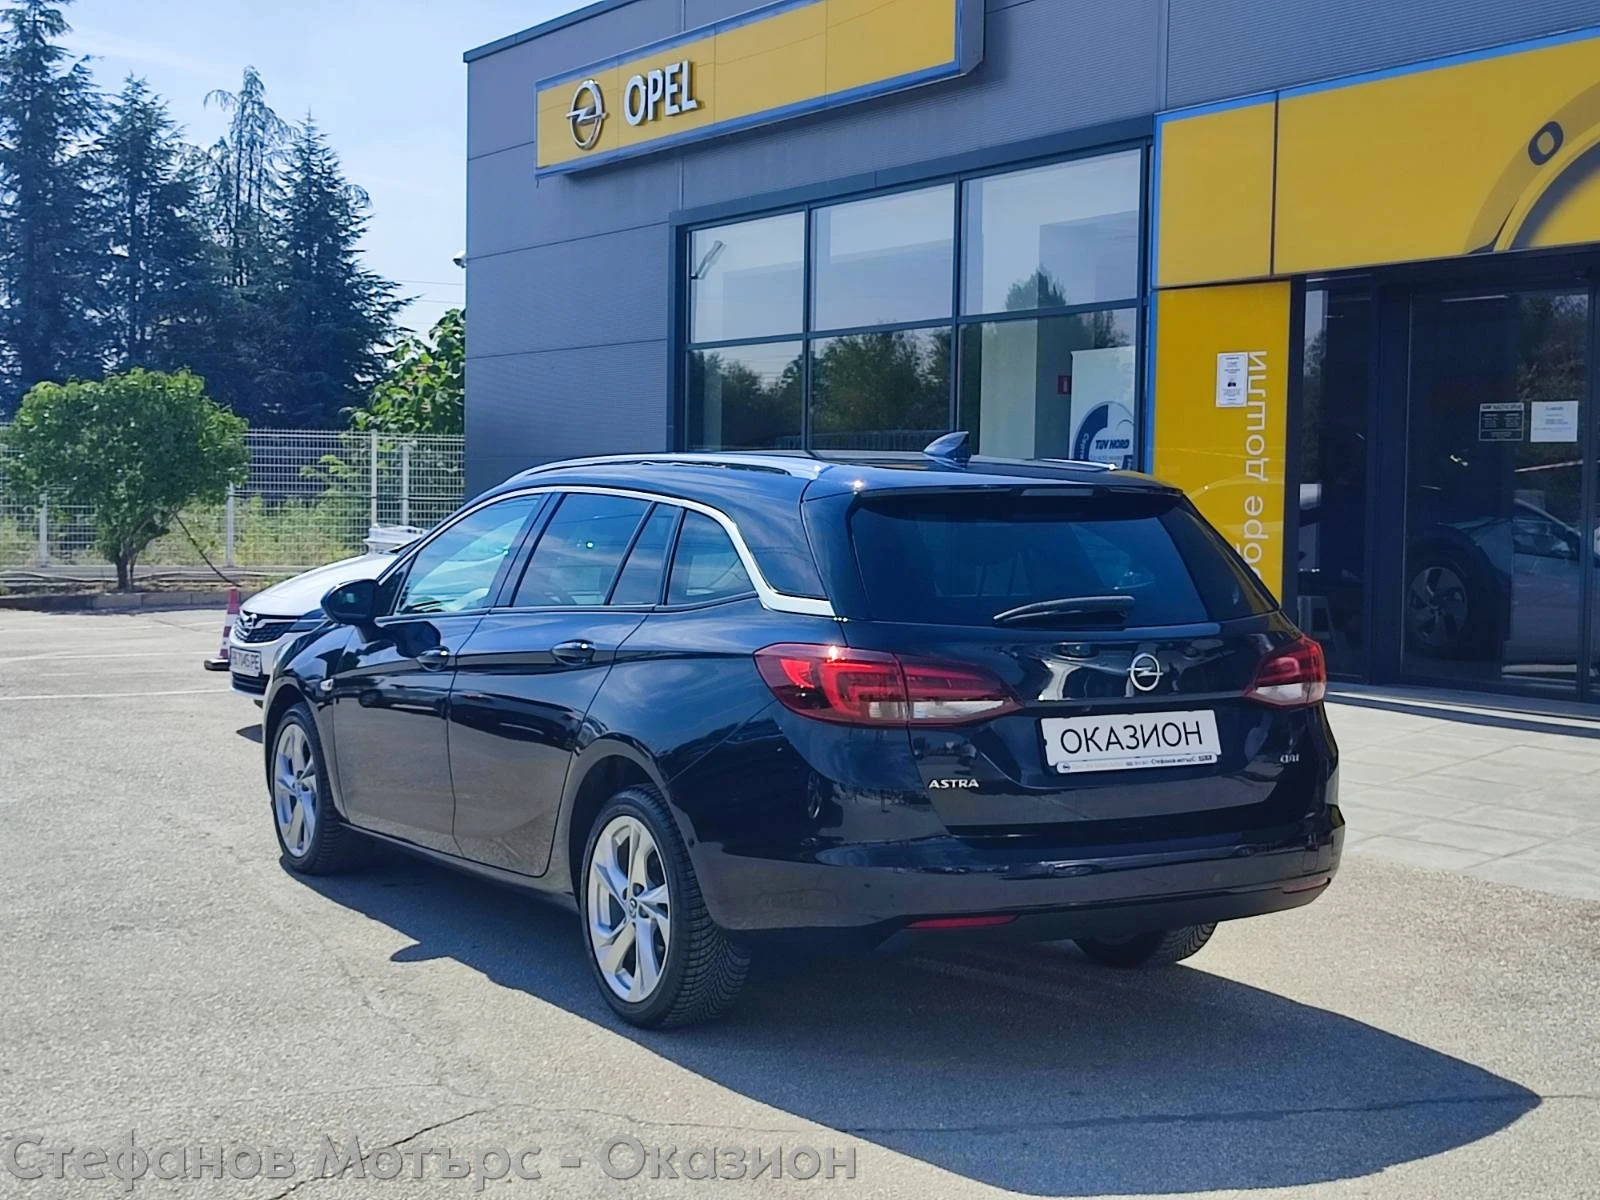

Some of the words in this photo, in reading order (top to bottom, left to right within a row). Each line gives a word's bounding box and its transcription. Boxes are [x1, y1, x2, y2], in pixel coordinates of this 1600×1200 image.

[623, 60, 699, 126] OPEL
[1246, 350, 1269, 482] дошли
[1236, 495, 1269, 580] бре
[1060, 721, 1204, 754] ОКАЗИОН
[928, 779, 980, 789] ASTRA
